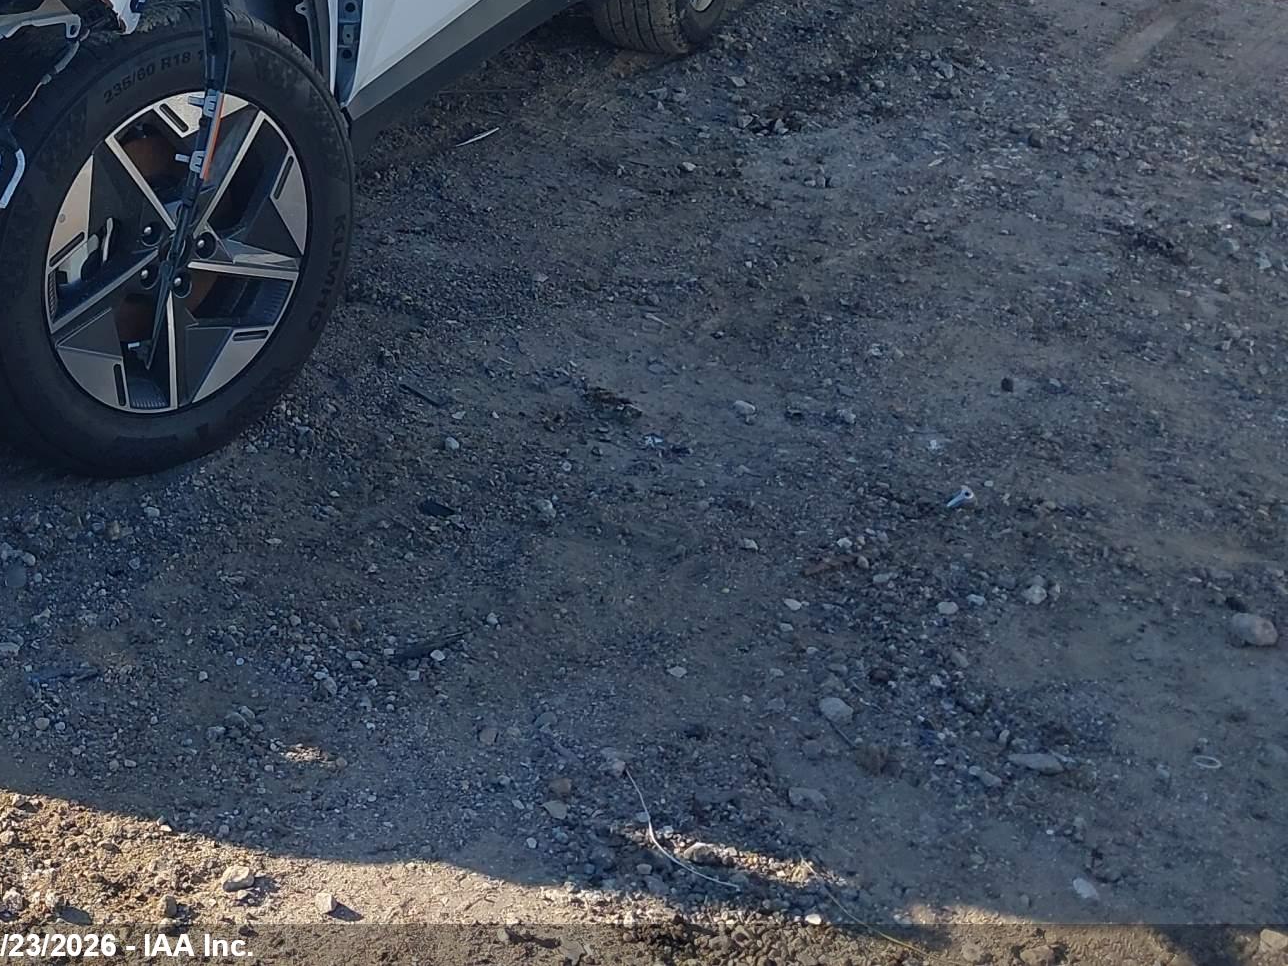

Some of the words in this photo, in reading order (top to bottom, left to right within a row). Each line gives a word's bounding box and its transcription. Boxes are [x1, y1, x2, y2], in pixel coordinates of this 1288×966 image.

[103, 62, 156, 105] 235/60
[162, 51, 191, 72] R18
[308, 213, 347, 331] KUMHO
